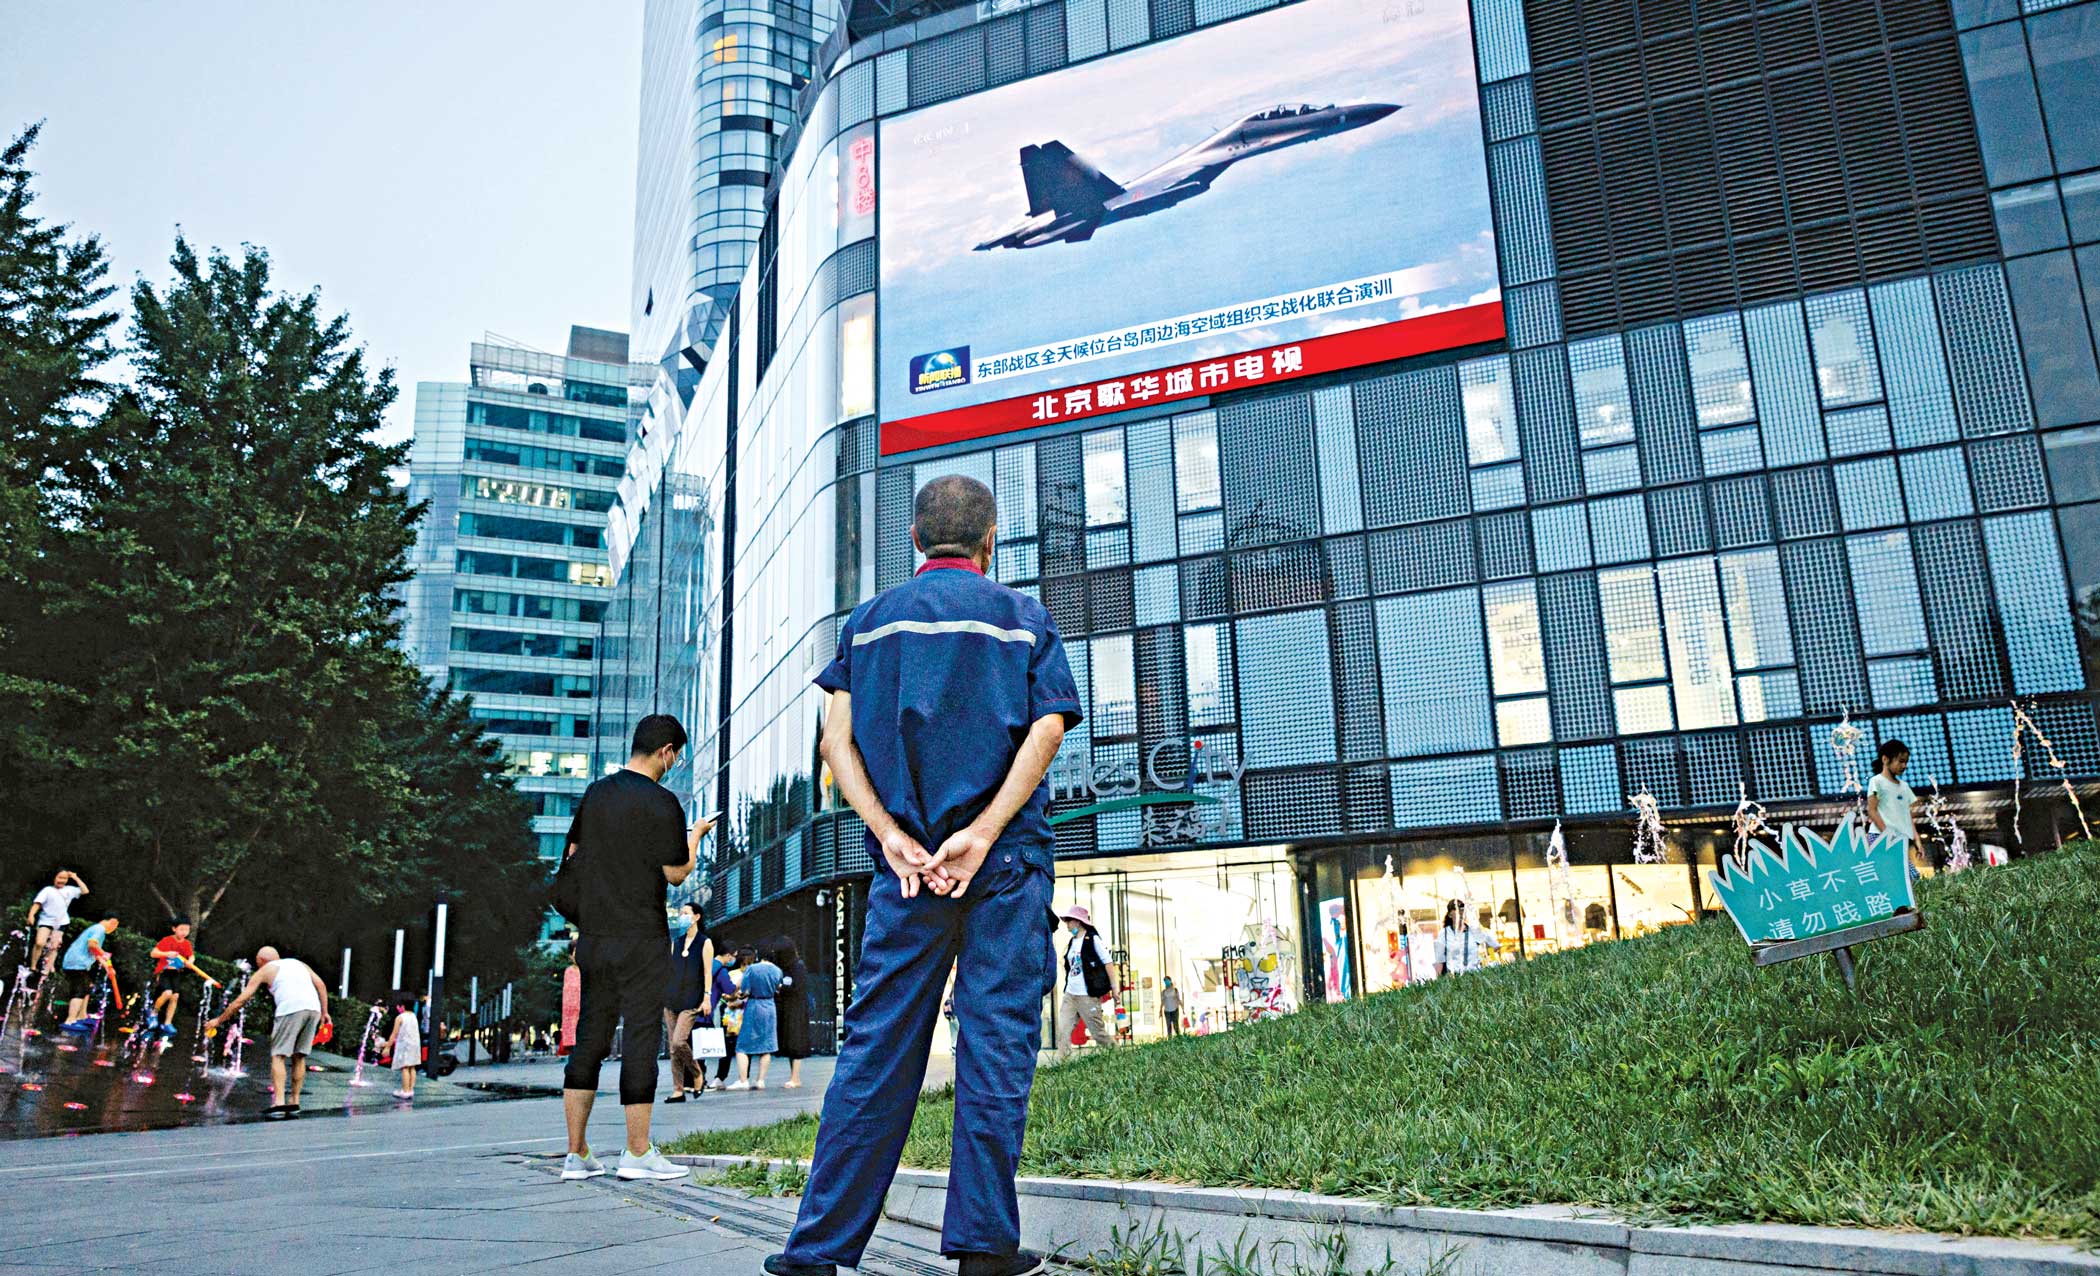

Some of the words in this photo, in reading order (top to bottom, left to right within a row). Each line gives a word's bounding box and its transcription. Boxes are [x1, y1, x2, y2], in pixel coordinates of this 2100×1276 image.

[977, 278, 1393, 378] 东部战区全天候位台岛周边海空域组织实战化联合演训
[1032, 346, 1304, 420] 北京歌华城市电视
[1049, 750, 1141, 800] ffles
[1148, 738, 1252, 796] City
[1137, 803, 1234, 848] 来福士
[1759, 860, 1880, 911] 小草不言
[836, 886, 845, 937] KARL
[1767, 891, 1894, 940] 请勿践踏
